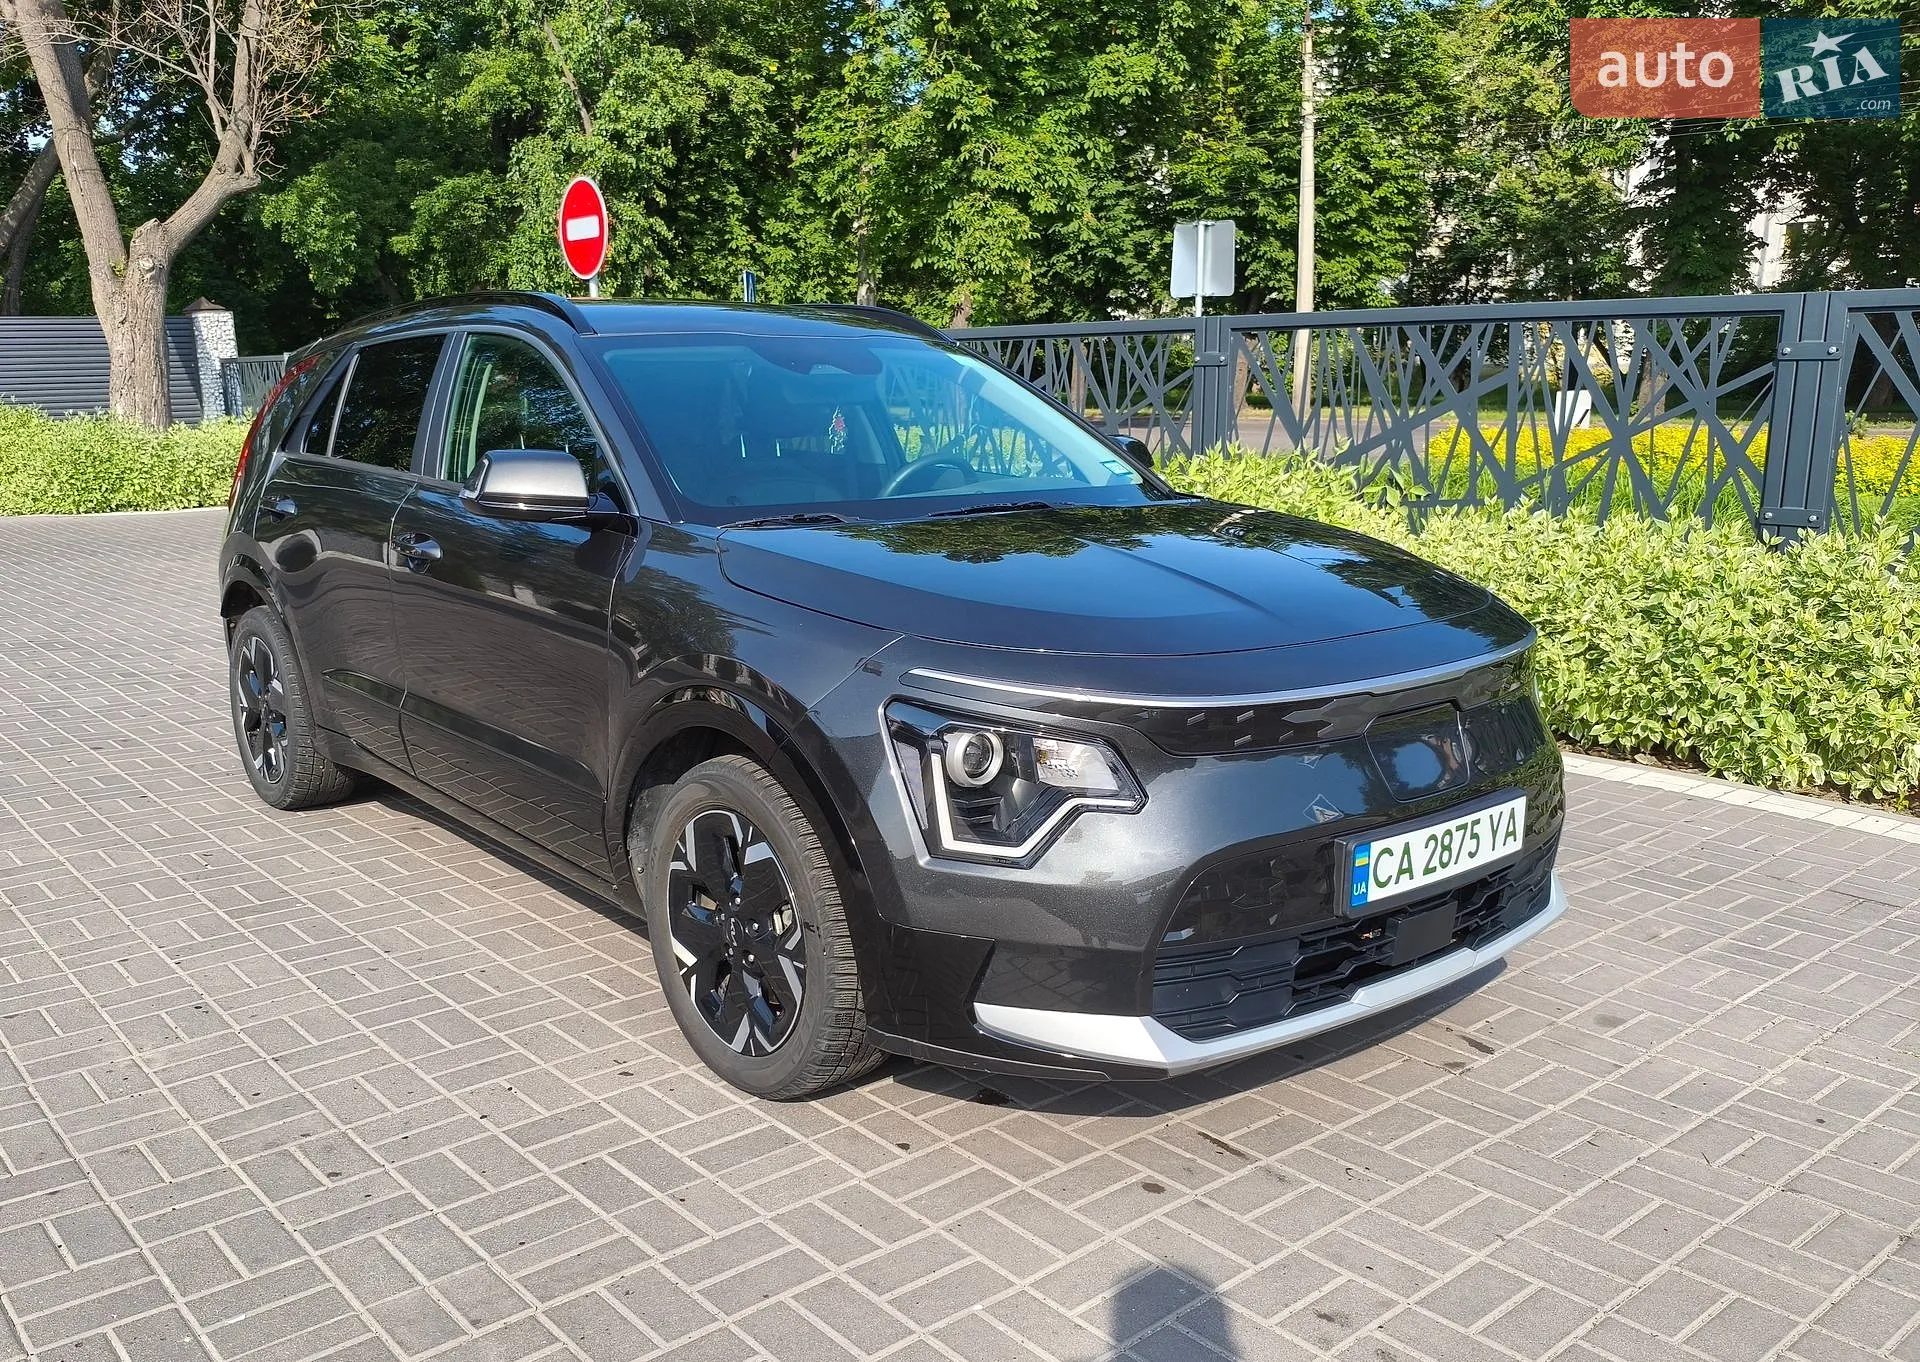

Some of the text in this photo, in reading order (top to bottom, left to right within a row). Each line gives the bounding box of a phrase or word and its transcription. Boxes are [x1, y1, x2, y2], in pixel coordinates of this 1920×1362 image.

[1373, 807, 1517, 889] CA 2875 YA
[1353, 881, 1367, 896] UA
